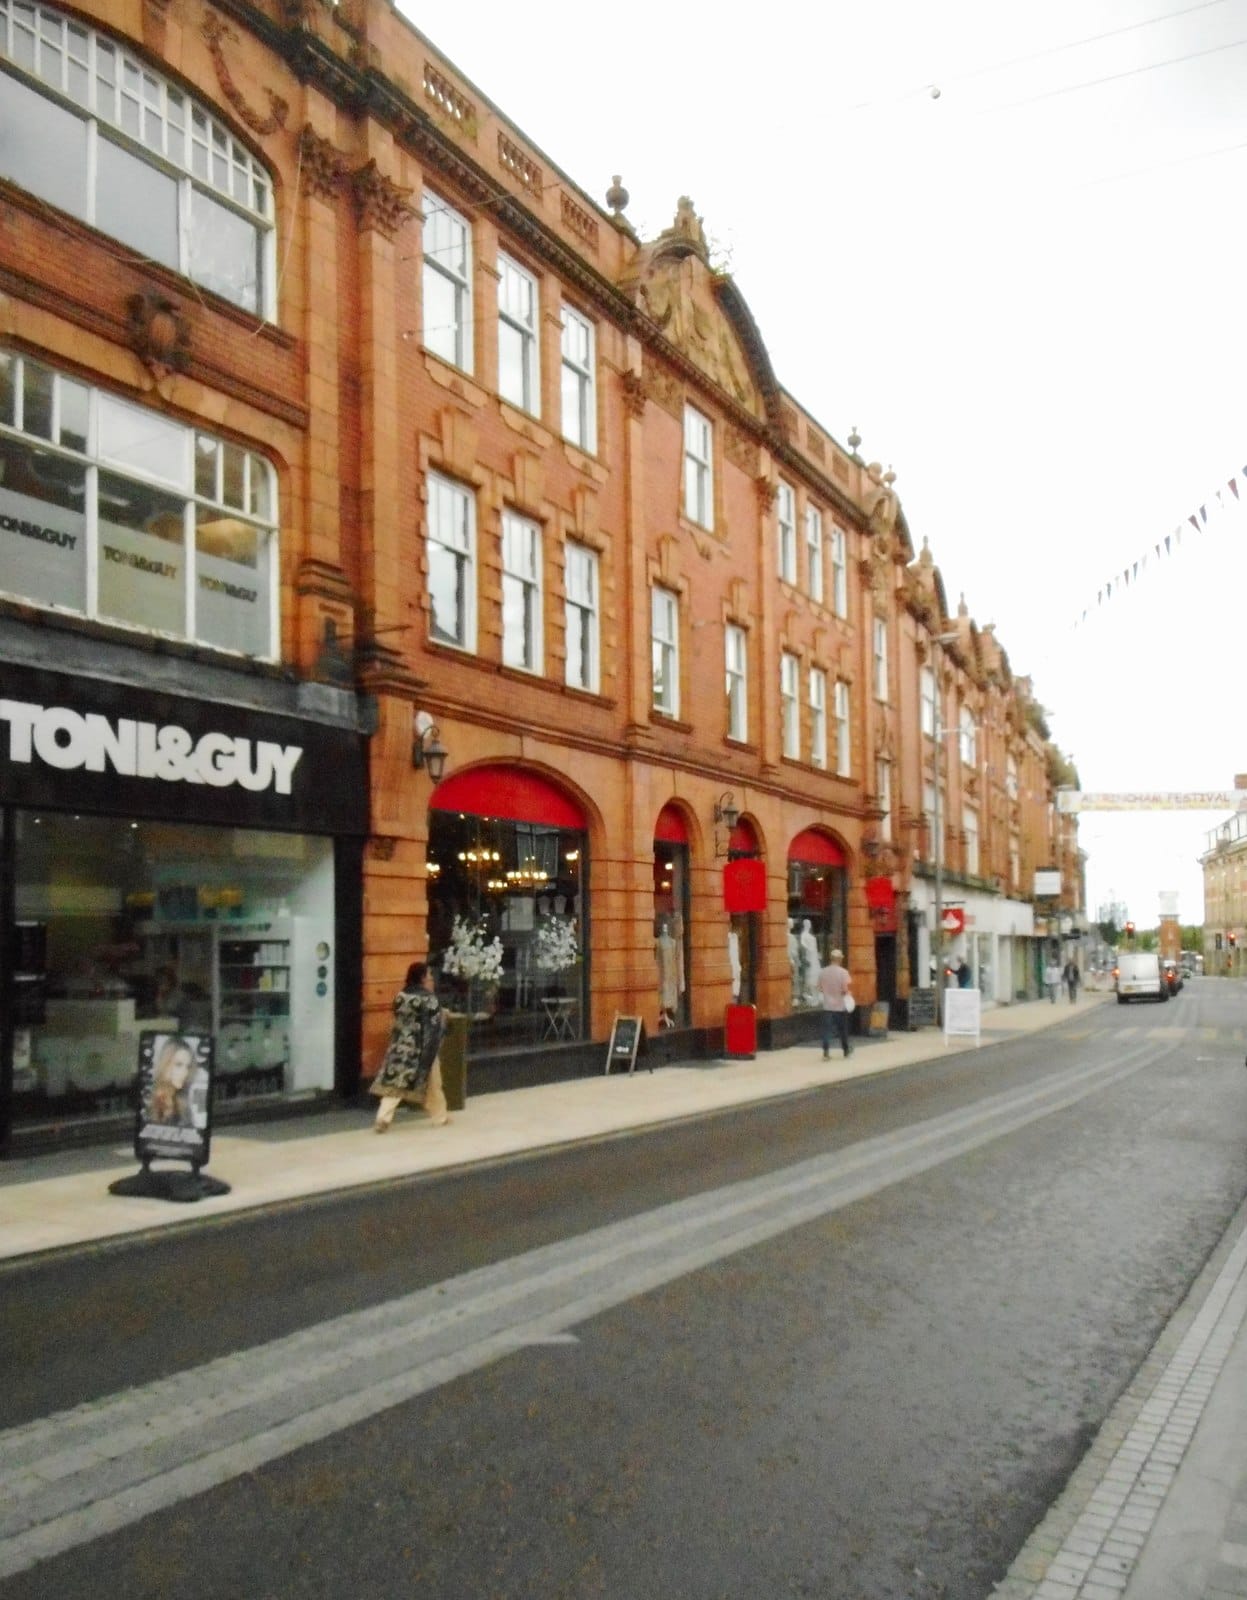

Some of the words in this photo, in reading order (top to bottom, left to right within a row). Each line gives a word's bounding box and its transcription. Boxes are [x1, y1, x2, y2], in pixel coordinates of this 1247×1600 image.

[0, 515, 76, 550] ONI&GUY
[0, 699, 303, 794] TONI&GUY
[1168, 792, 1229, 803] FESTIVAL
